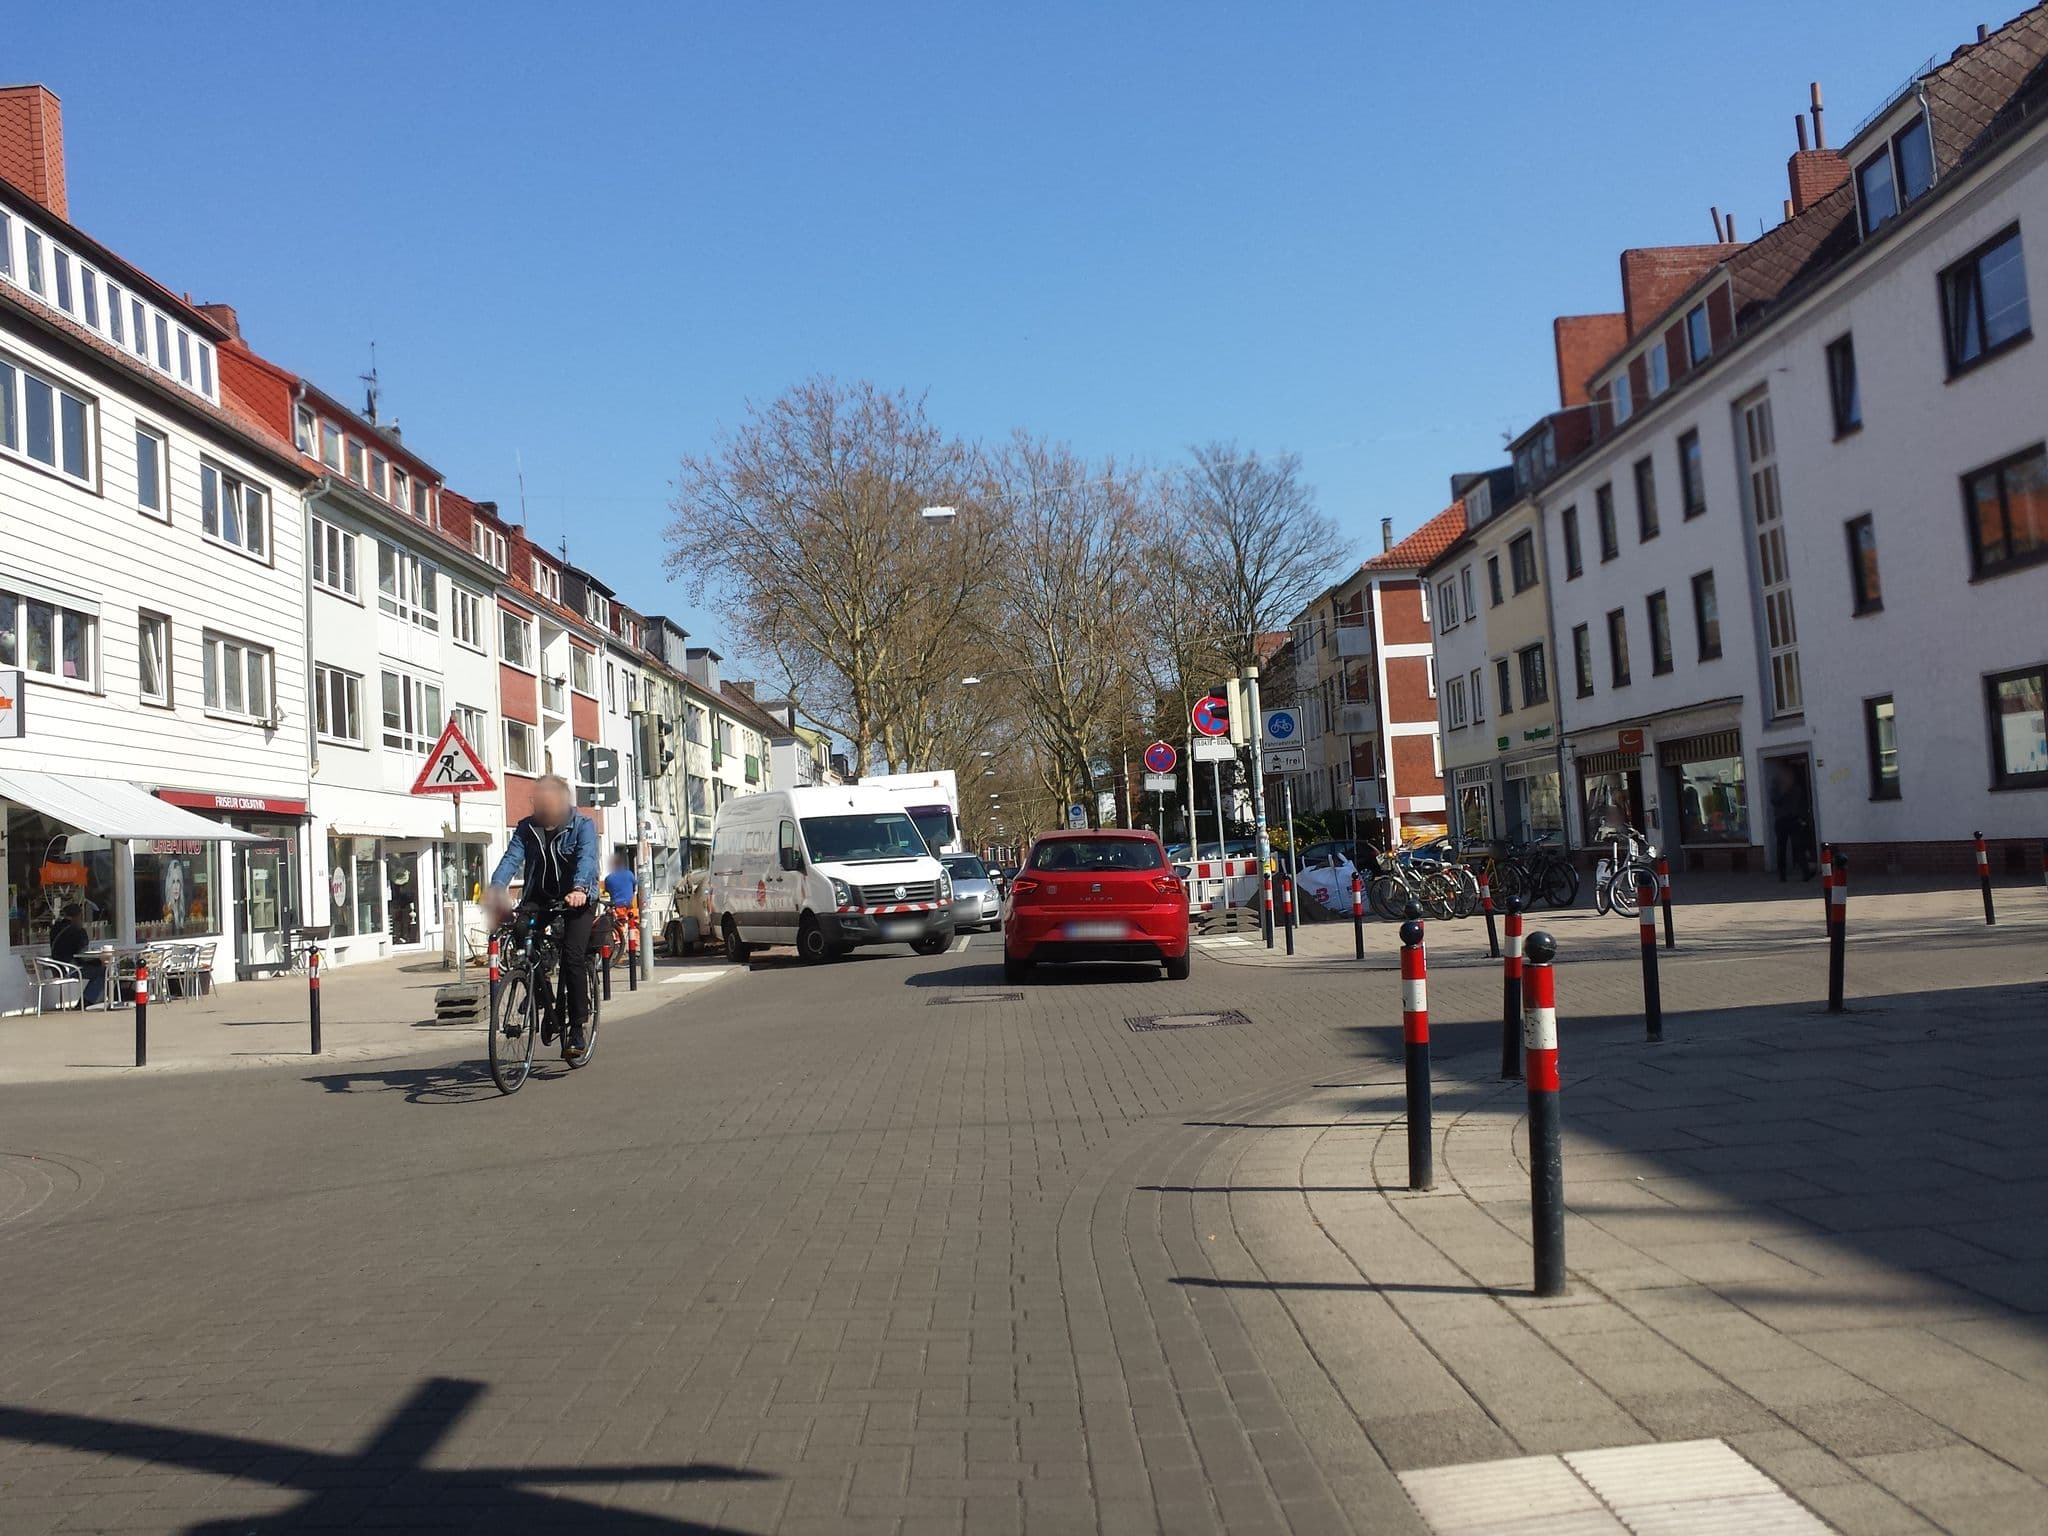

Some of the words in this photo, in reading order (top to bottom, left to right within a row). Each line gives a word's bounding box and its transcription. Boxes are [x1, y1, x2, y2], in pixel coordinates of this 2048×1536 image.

[1286, 756, 1301, 766] frei
[215, 796, 238, 808] FRISEUR
[239, 798, 265, 810] CREATIVO
